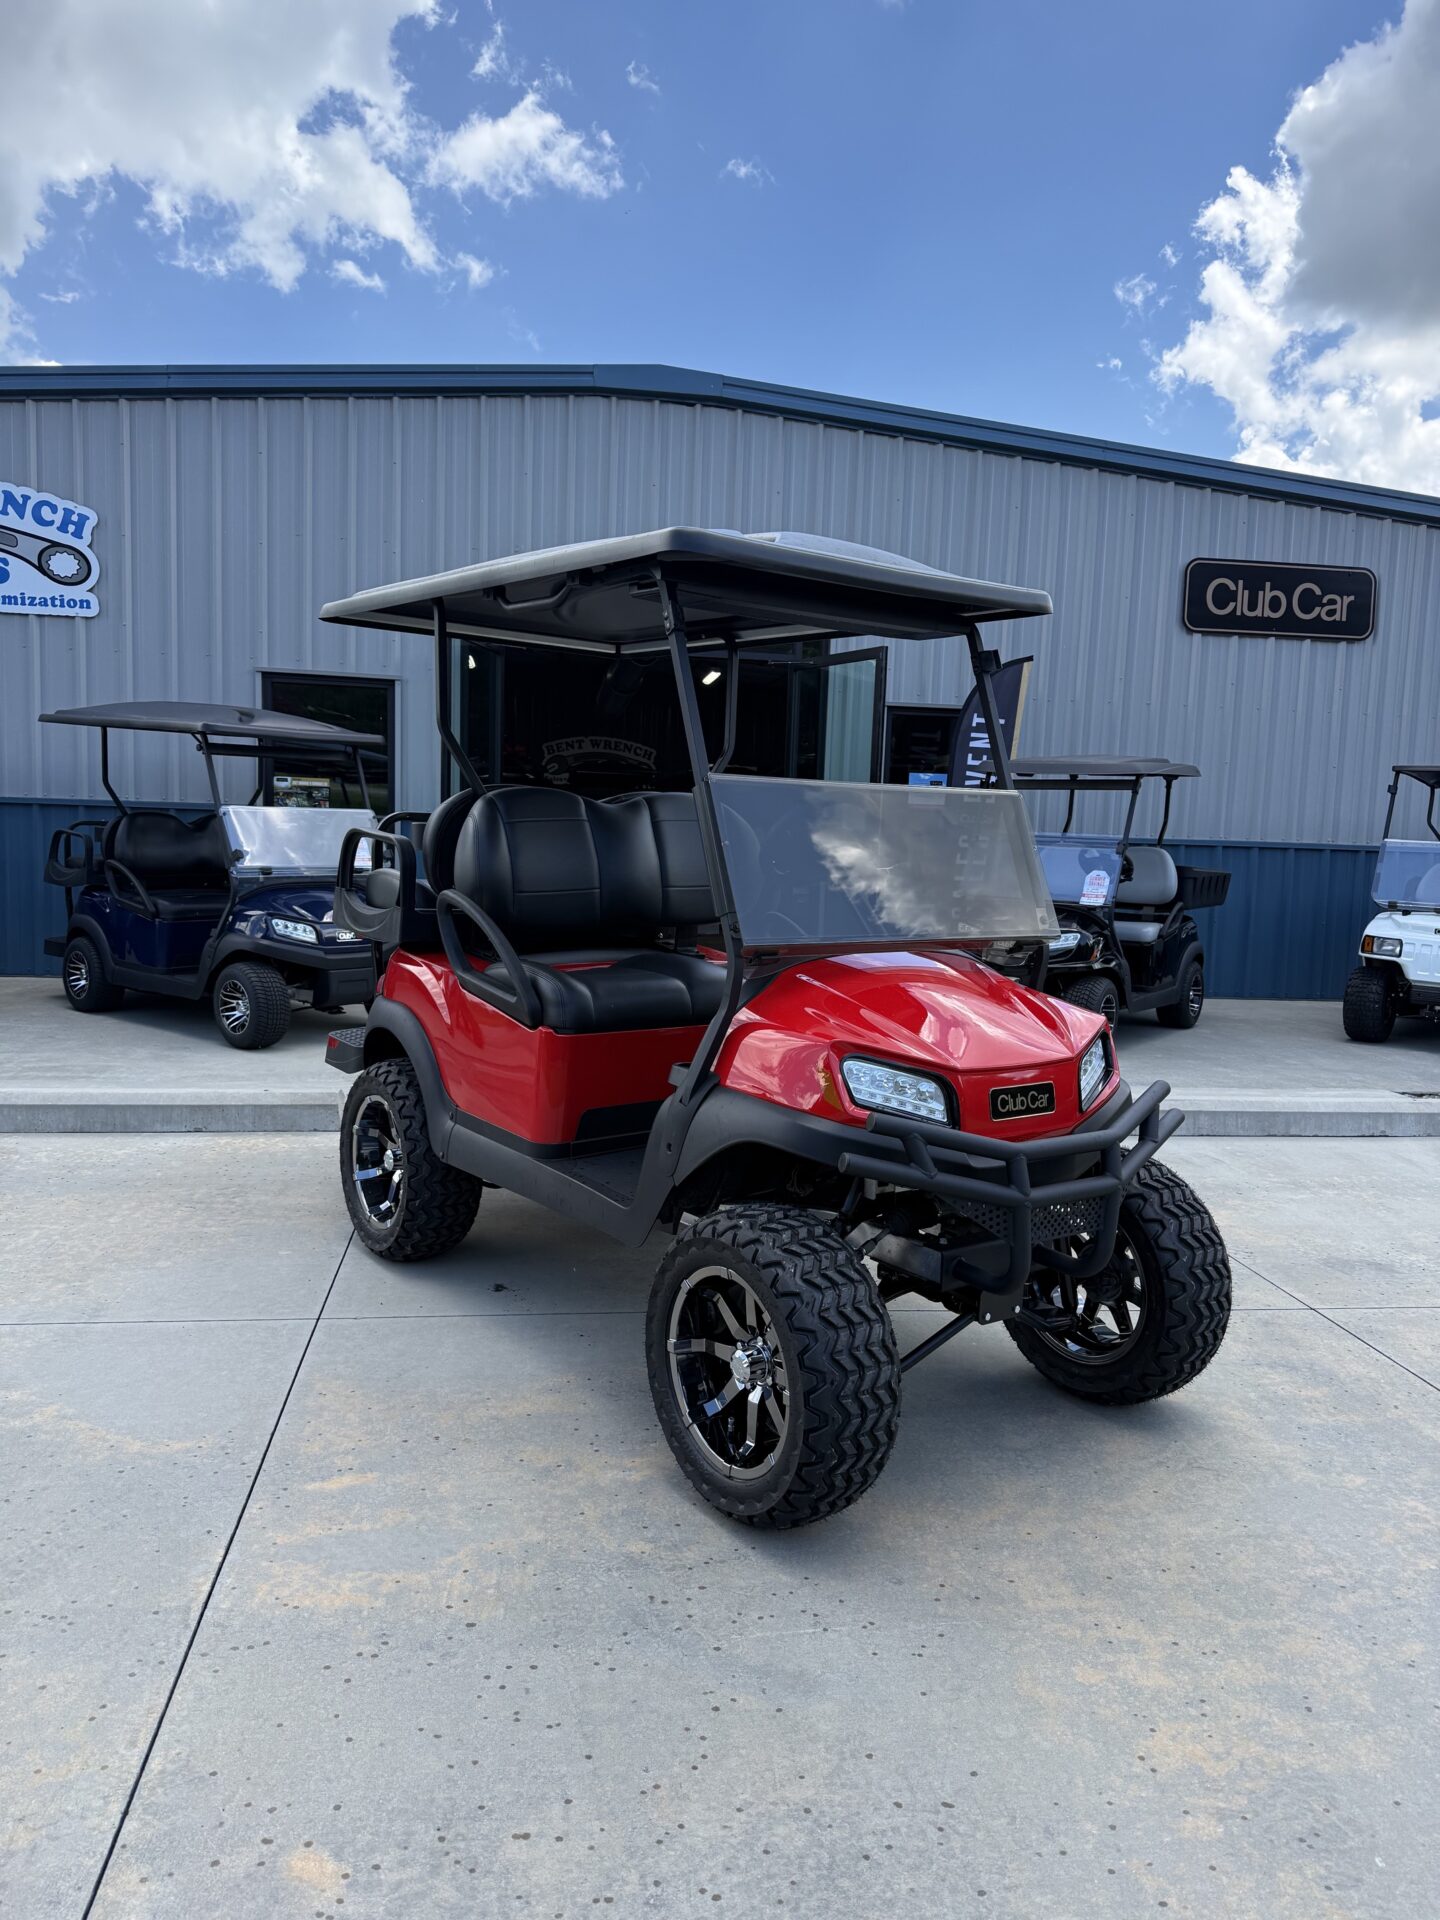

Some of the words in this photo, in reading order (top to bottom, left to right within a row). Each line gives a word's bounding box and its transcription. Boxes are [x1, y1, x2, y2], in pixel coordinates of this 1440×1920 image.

[0, 489, 90, 540] NCH
[0, 592, 92, 610] mization
[1206, 577, 1287, 619] Club
[1292, 582, 1355, 622] Car
[545, 738, 585, 756] BENT
[588, 738, 655, 761] WRENCH
[997, 1093, 1027, 1113] Club
[1027, 1091, 1050, 1109] Car
